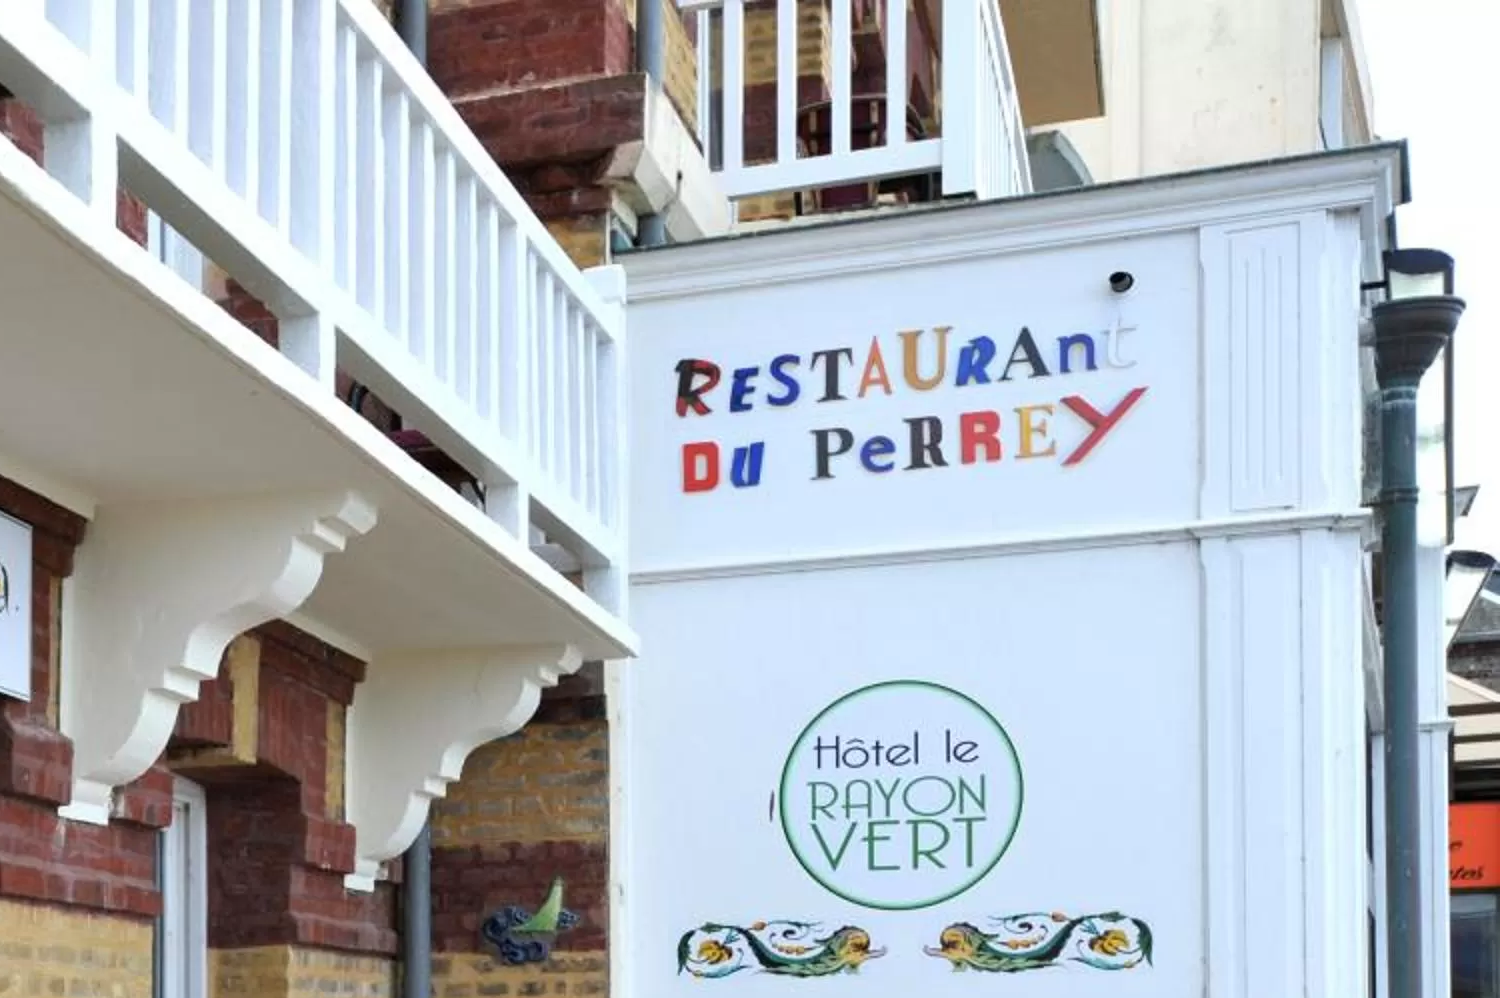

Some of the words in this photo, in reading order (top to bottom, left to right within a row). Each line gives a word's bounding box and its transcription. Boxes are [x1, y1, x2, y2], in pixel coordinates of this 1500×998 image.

[813, 731, 919, 769] Hôtel
[945, 729, 980, 765] le
[806, 773, 986, 822] RAYON
[810, 816, 987, 872] VERT
